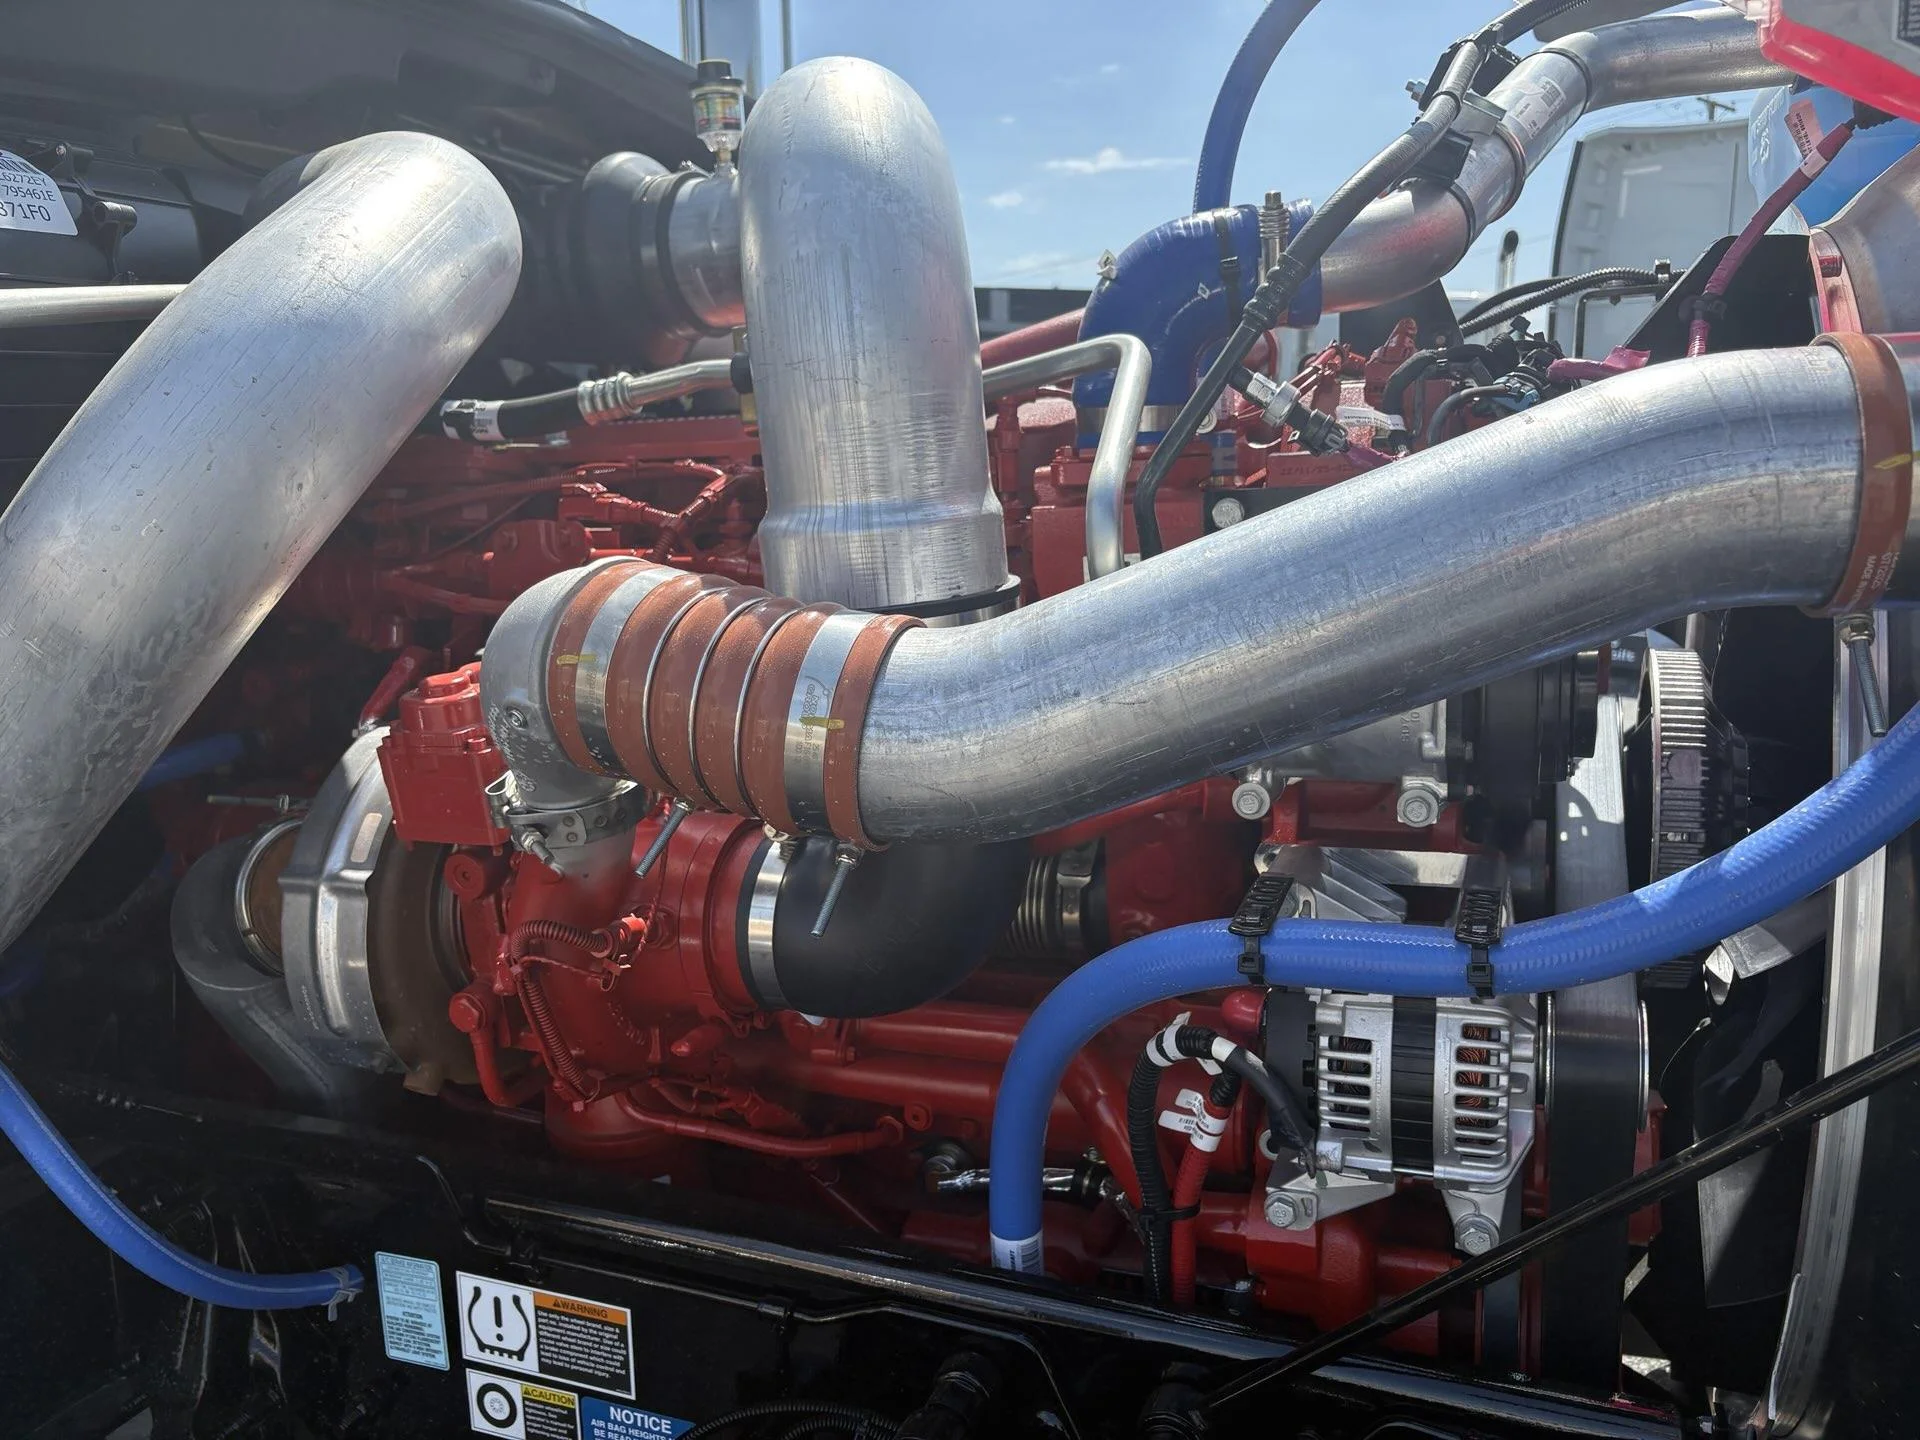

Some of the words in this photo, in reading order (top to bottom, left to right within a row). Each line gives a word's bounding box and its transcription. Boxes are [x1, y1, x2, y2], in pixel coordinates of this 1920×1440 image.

[560, 1300, 608, 1318] WARNING
[531, 1389, 574, 1405] CAUTION
[591, 1418, 606, 1428] AIR
[608, 1422, 626, 1433] BAG
[609, 1406, 672, 1434] NOTICE
[594, 1428, 606, 1438] BE
